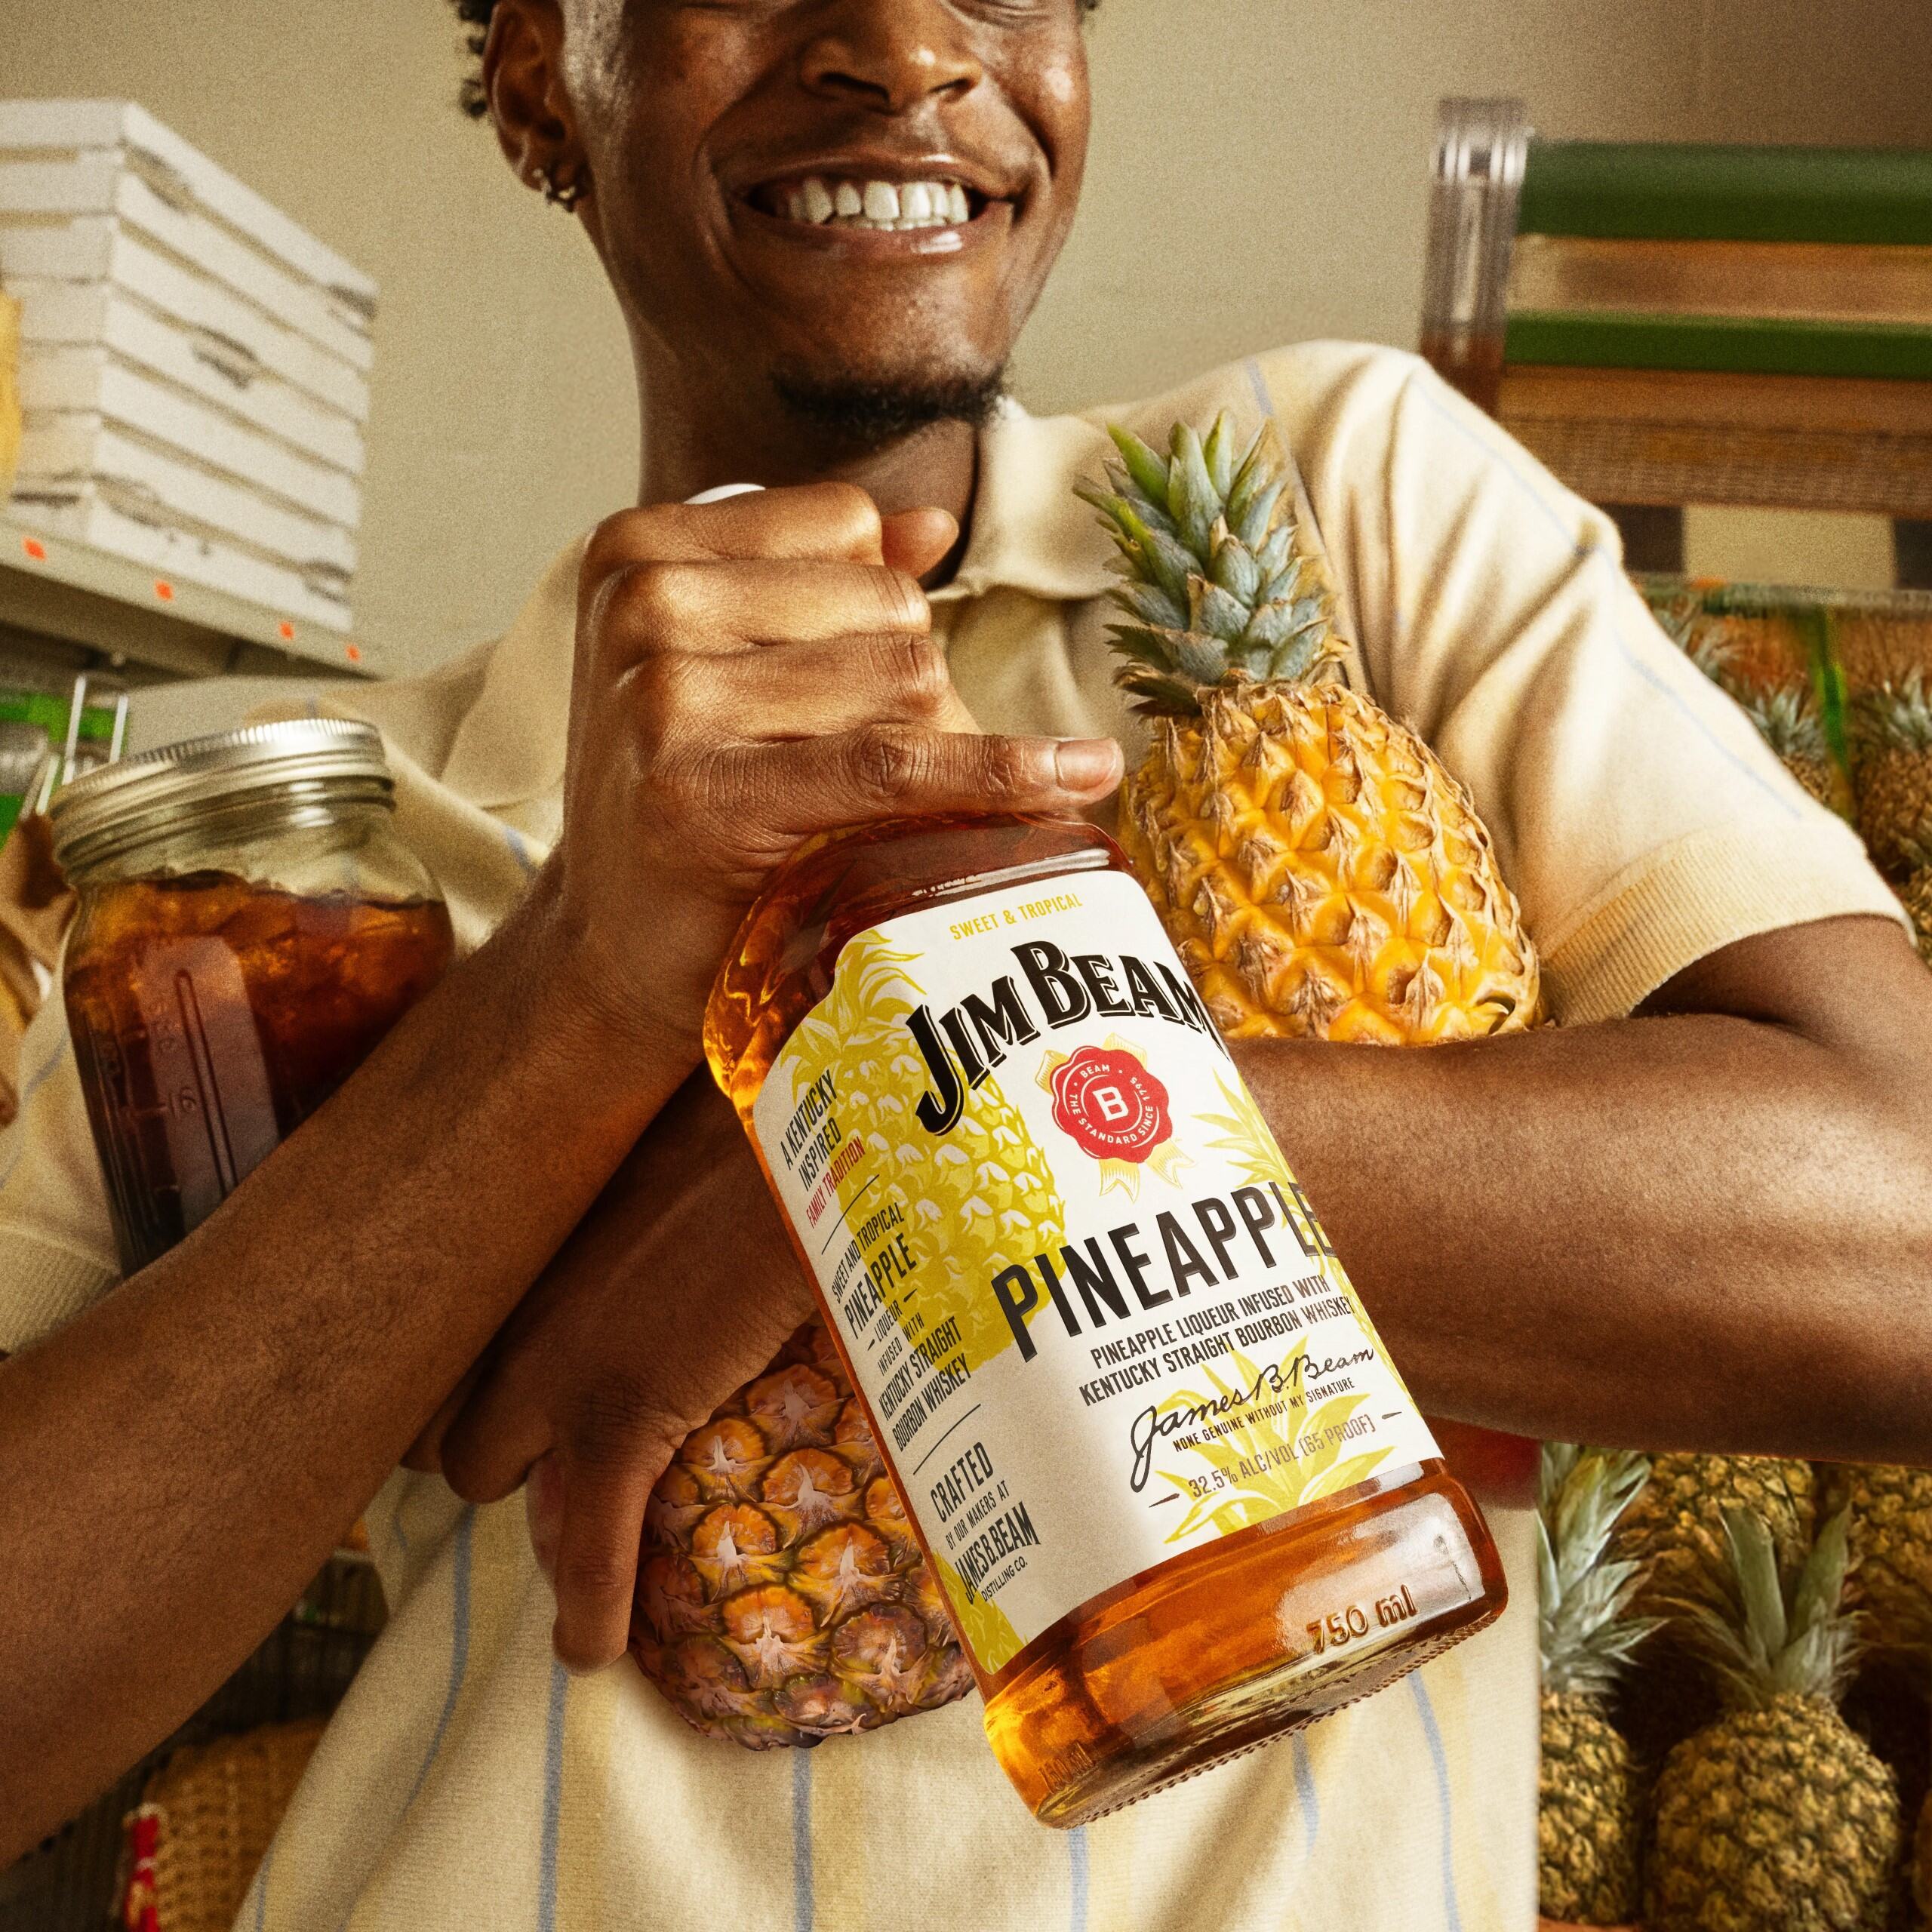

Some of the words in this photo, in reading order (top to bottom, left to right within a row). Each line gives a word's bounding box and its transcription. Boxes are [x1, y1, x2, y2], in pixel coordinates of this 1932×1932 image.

[949, 913, 1000, 940] SWEET
[1004, 909, 1017, 924] &
[1018, 893, 1083, 921] TROPICAL
[905, 975, 1041, 1137] JIM
[1011, 940, 1232, 1063] BEAM
[1079, 1064, 1110, 1078] BEAM
[785, 1069, 838, 1158] KENTUCKY
[1069, 1094, 1081, 1115] THE
[1092, 1086, 1129, 1121] B
[1130, 1077, 1151, 1100] 1795
[1137, 1106, 1153, 1136] SINCE
[780, 1141, 793, 1171] A
[798, 1117, 841, 1192] INSPIRED
[1078, 1118, 1138, 1145] STANDARD
[805, 1186, 827, 1229] FAMILY
[822, 1136, 866, 1197] TRADITION
[832, 1259, 850, 1304] SWEET
[844, 1239, 861, 1269] AND
[857, 1202, 905, 1251] TROPICAL
[844, 1232, 917, 1340] PINEAPPLE
[990, 1181, 1337, 1363] PINEAPPLE
[874, 1300, 903, 1342] LIQUEUR
[877, 1337, 903, 1377] INFUSED
[902, 1312, 924, 1342] WITH
[1078, 1360, 1162, 1407] KENTUCKY
[1163, 1334, 1235, 1373] STRAIGHT
[1235, 1309, 1303, 1347] BOURBON
[1300, 1296, 1355, 1324] WHISKEY
[1090, 1327, 1177, 1370] PINEAPPLE
[1176, 1300, 1240, 1339] LIQUEUR
[1238, 1284, 1295, 1317] INFUSED
[1292, 1274, 1331, 1299] WITH
[878, 1361, 915, 1421] KENTUCKY
[909, 1315, 962, 1379] STRAIGHT
[892, 1396, 928, 1452] BOURBON
[921, 1352, 971, 1413] WHISKEY
[1131, 1389, 1250, 1493] James
[1291, 1348, 1374, 1387] Beam
[1172, 1435, 1201, 1453] NONE
[1201, 1420, 1244, 1441] GENUINE
[1244, 1400, 1289, 1425] WITHOUT
[1290, 1394, 1305, 1409] MY
[1305, 1377, 1355, 1404] SIGNATURE
[930, 1441, 994, 1523] CRAFTED
[1188, 1466, 1238, 1498] 32.5%
[1238, 1443, 1300, 1479] ALC/VOL
[945, 1534, 956, 1551] BY
[953, 1518, 969, 1542] OUR
[966, 1491, 997, 1529] MAKERS
[996, 1479, 1010, 1502] AT
[988, 1501, 1041, 1558] BEAM
[981, 1564, 1015, 1602] DISTILLING
[1014, 1556, 1028, 1572] CO.
[1306, 1604, 1369, 1654] 750
[1375, 1584, 1418, 1627] ml
